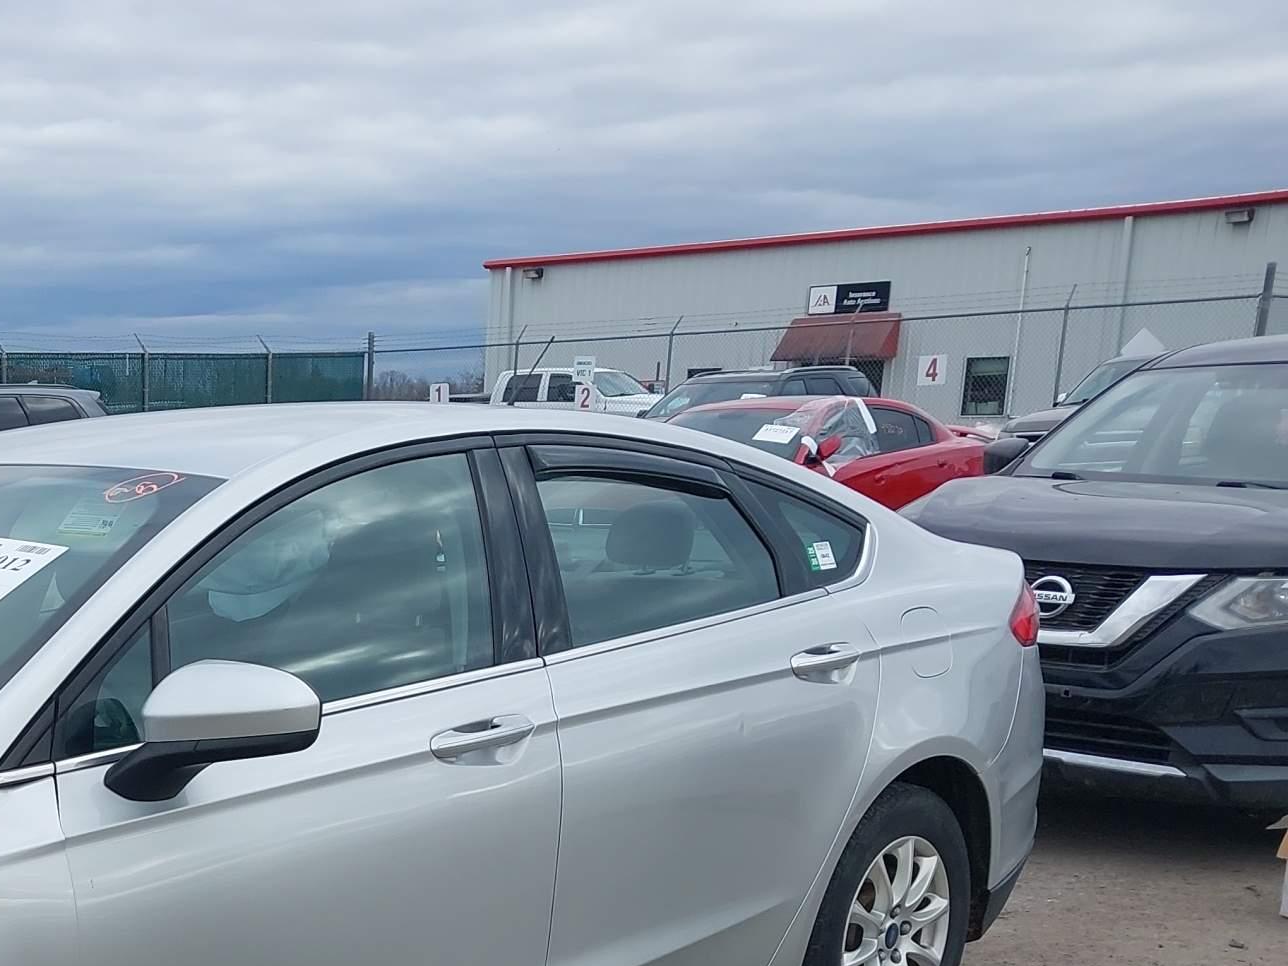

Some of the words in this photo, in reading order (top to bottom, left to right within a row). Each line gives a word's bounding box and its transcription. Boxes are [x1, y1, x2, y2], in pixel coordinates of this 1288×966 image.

[925, 357, 938, 381] 4
[434, 386, 442, 402] 1
[580, 387, 591, 409] 2
[1033, 592, 1068, 602] ISSAN
